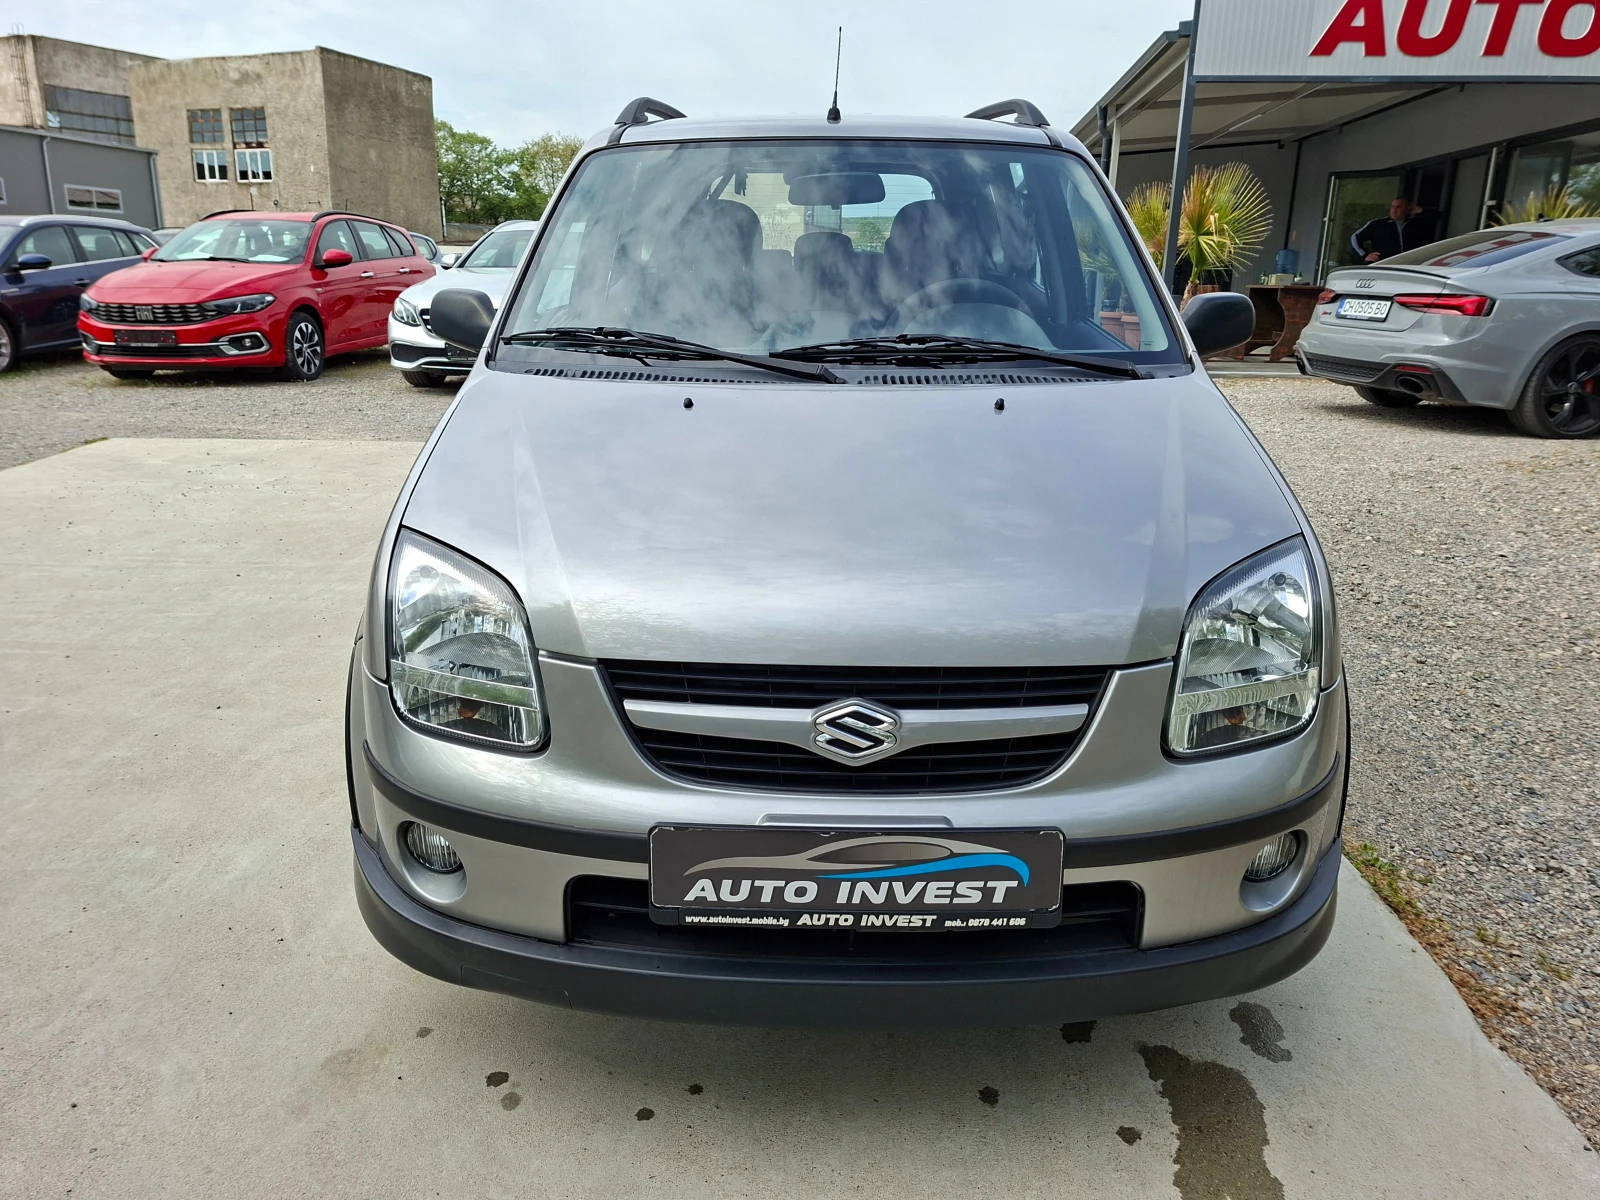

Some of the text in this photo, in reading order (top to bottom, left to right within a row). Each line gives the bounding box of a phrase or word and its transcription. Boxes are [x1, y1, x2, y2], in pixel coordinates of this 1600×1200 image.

[1308, 0, 1600, 57] AUTO
[683, 878, 1019, 905] AUTO INVEST
[685, 915, 789, 926] www.autoinvest.mobile.bg
[796, 913, 854, 926] AUTO
[860, 914, 937, 927] INVEST
[967, 918, 990, 927] 0878
[990, 918, 1007, 926] 441
